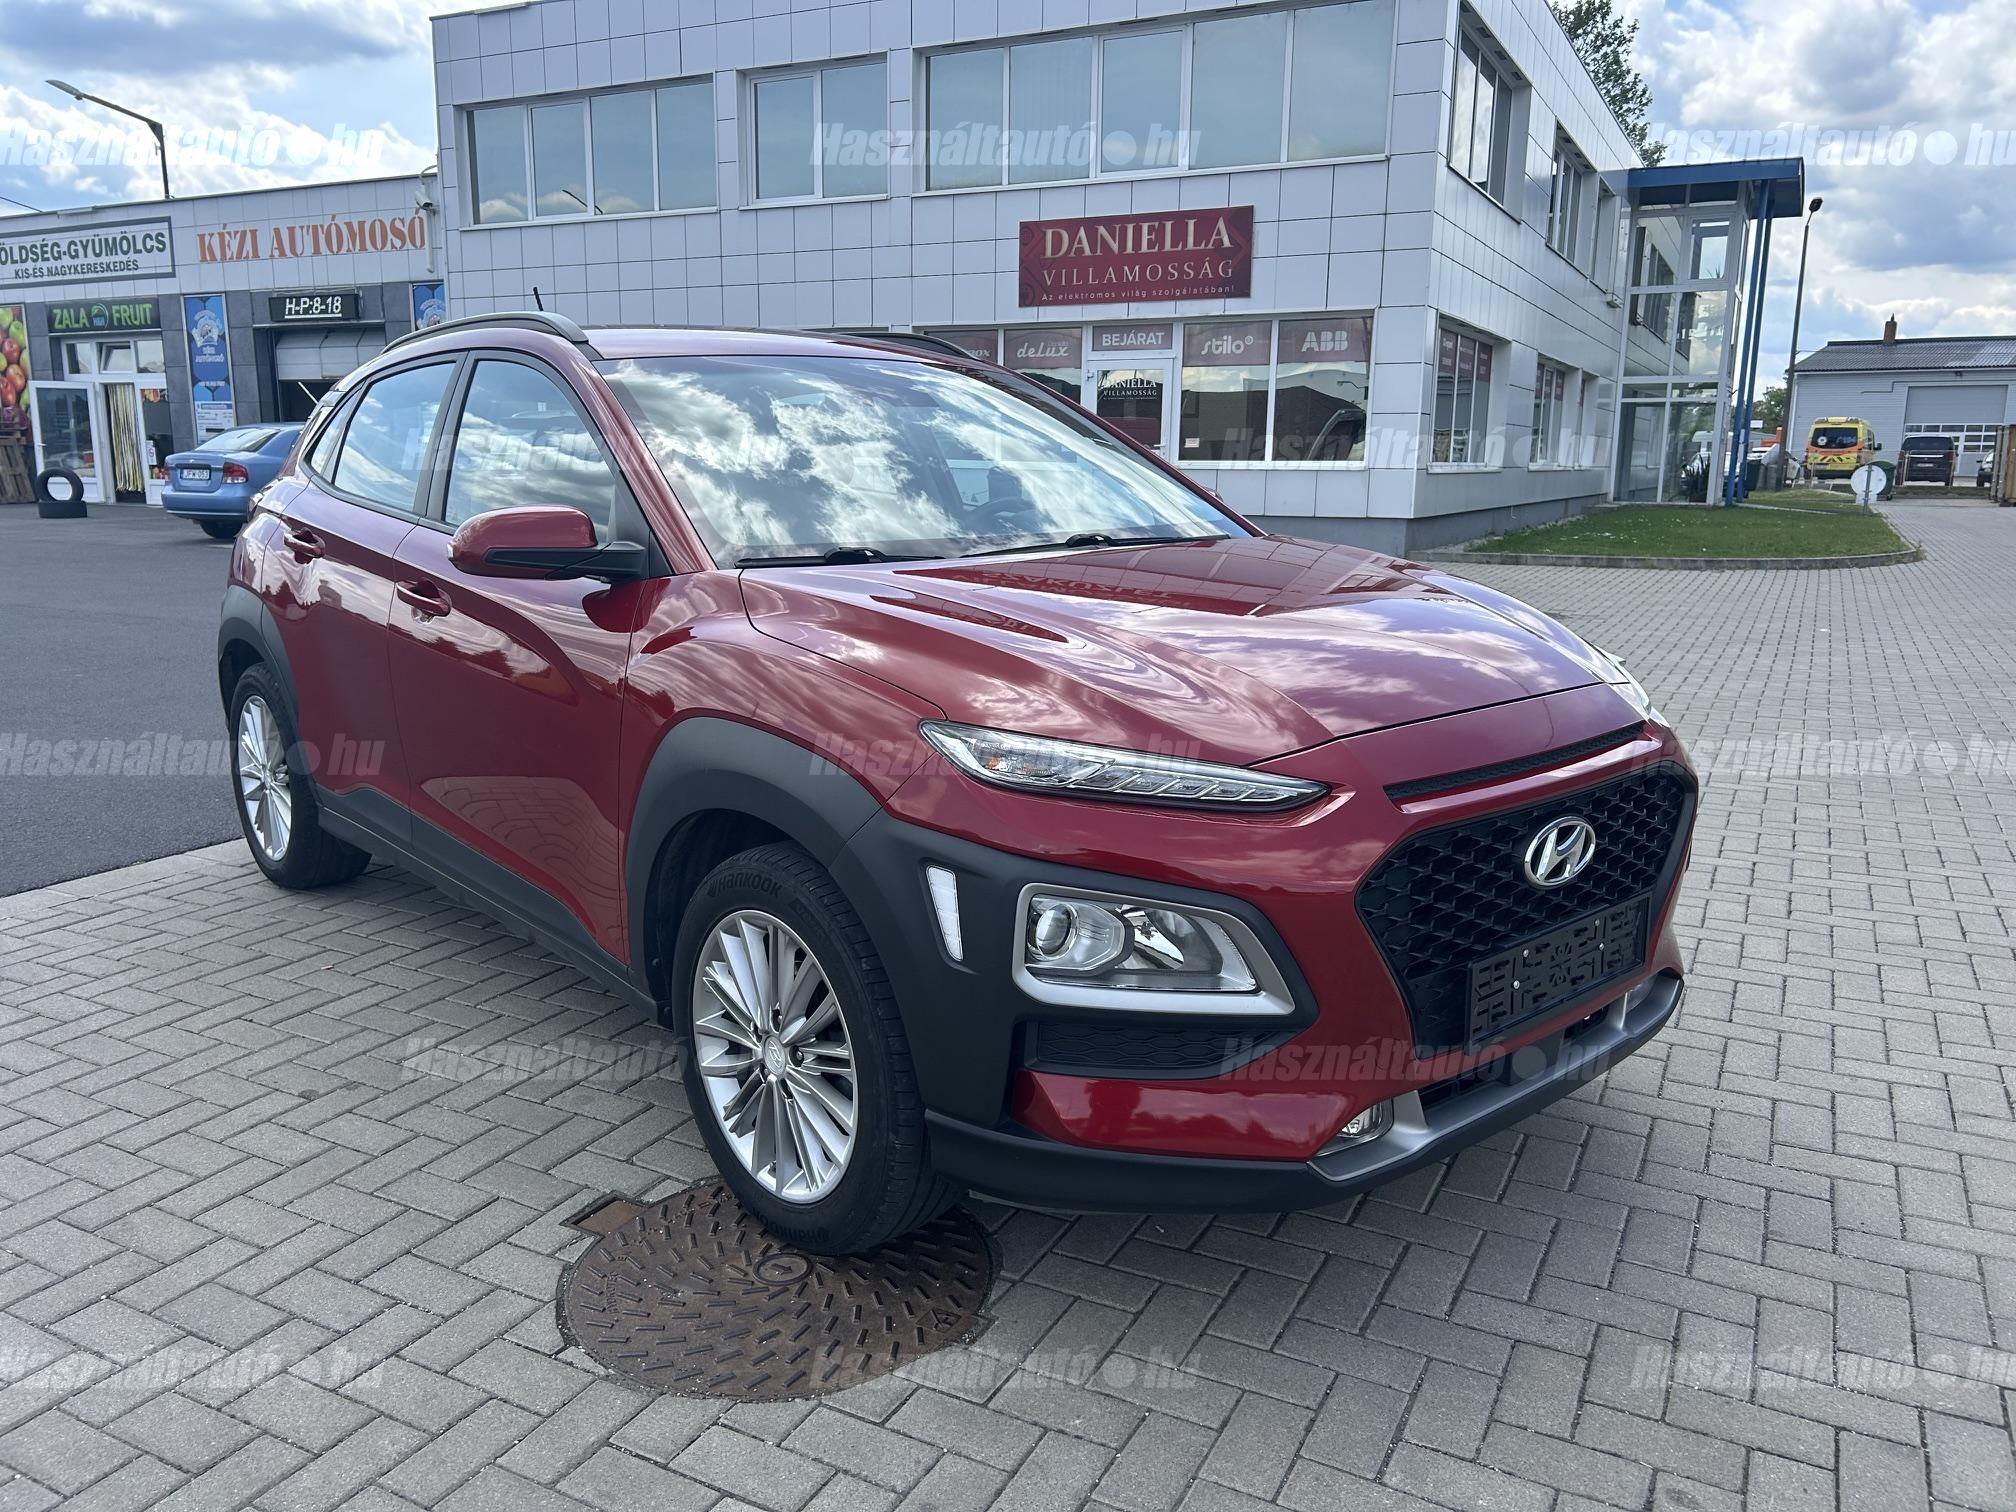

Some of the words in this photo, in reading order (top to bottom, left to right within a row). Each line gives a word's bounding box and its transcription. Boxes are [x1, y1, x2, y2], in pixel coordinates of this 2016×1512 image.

[197, 223, 262, 263] KÉZI
[269, 208, 427, 258] AUTÓMOSÓ
[1042, 216, 1234, 259] DANIELLA
[47, 257, 139, 277] NAGYKERESKEDÉS
[1042, 257, 1234, 287] VILLAMOSSÁG
[1041, 293, 1053, 301] Az
[1058, 290, 1116, 300] elektromos
[1121, 288, 1147, 298] világ
[1152, 286, 1235, 296] szolgálatában!
[53, 308, 90, 329] ZALA
[112, 303, 152, 326] FRUIT
[1102, 330, 1165, 346] BEJÁRAT
[1301, 330, 1349, 352] ABB
[1104, 378, 1157, 388] ANIELLA
